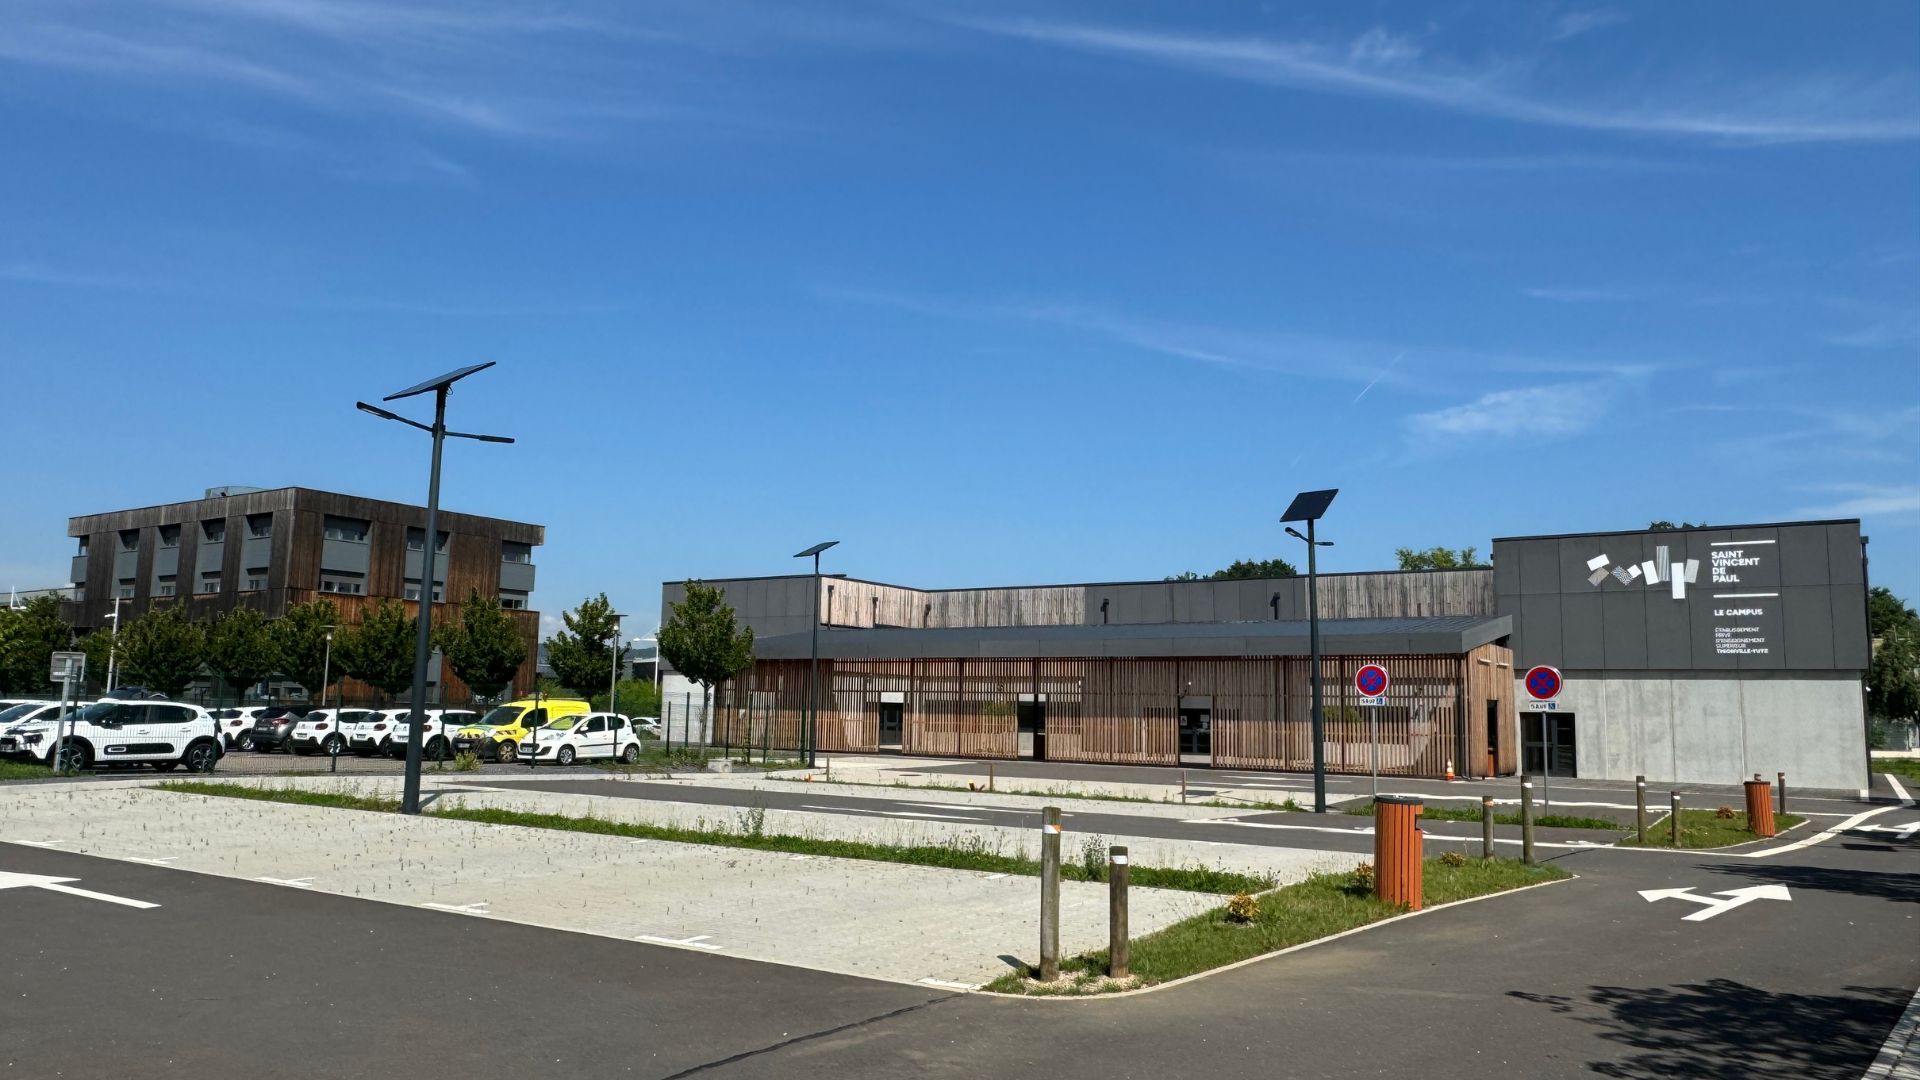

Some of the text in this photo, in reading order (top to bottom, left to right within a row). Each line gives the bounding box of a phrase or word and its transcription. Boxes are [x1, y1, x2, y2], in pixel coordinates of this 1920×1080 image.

[1711, 550, 1744, 559] SAINT
[1711, 558, 1760, 566] VINCENT
[1712, 567, 1726, 575] DE
[1712, 574, 1740, 583] PAUL
[1726, 608, 1763, 616] CAMPUS
